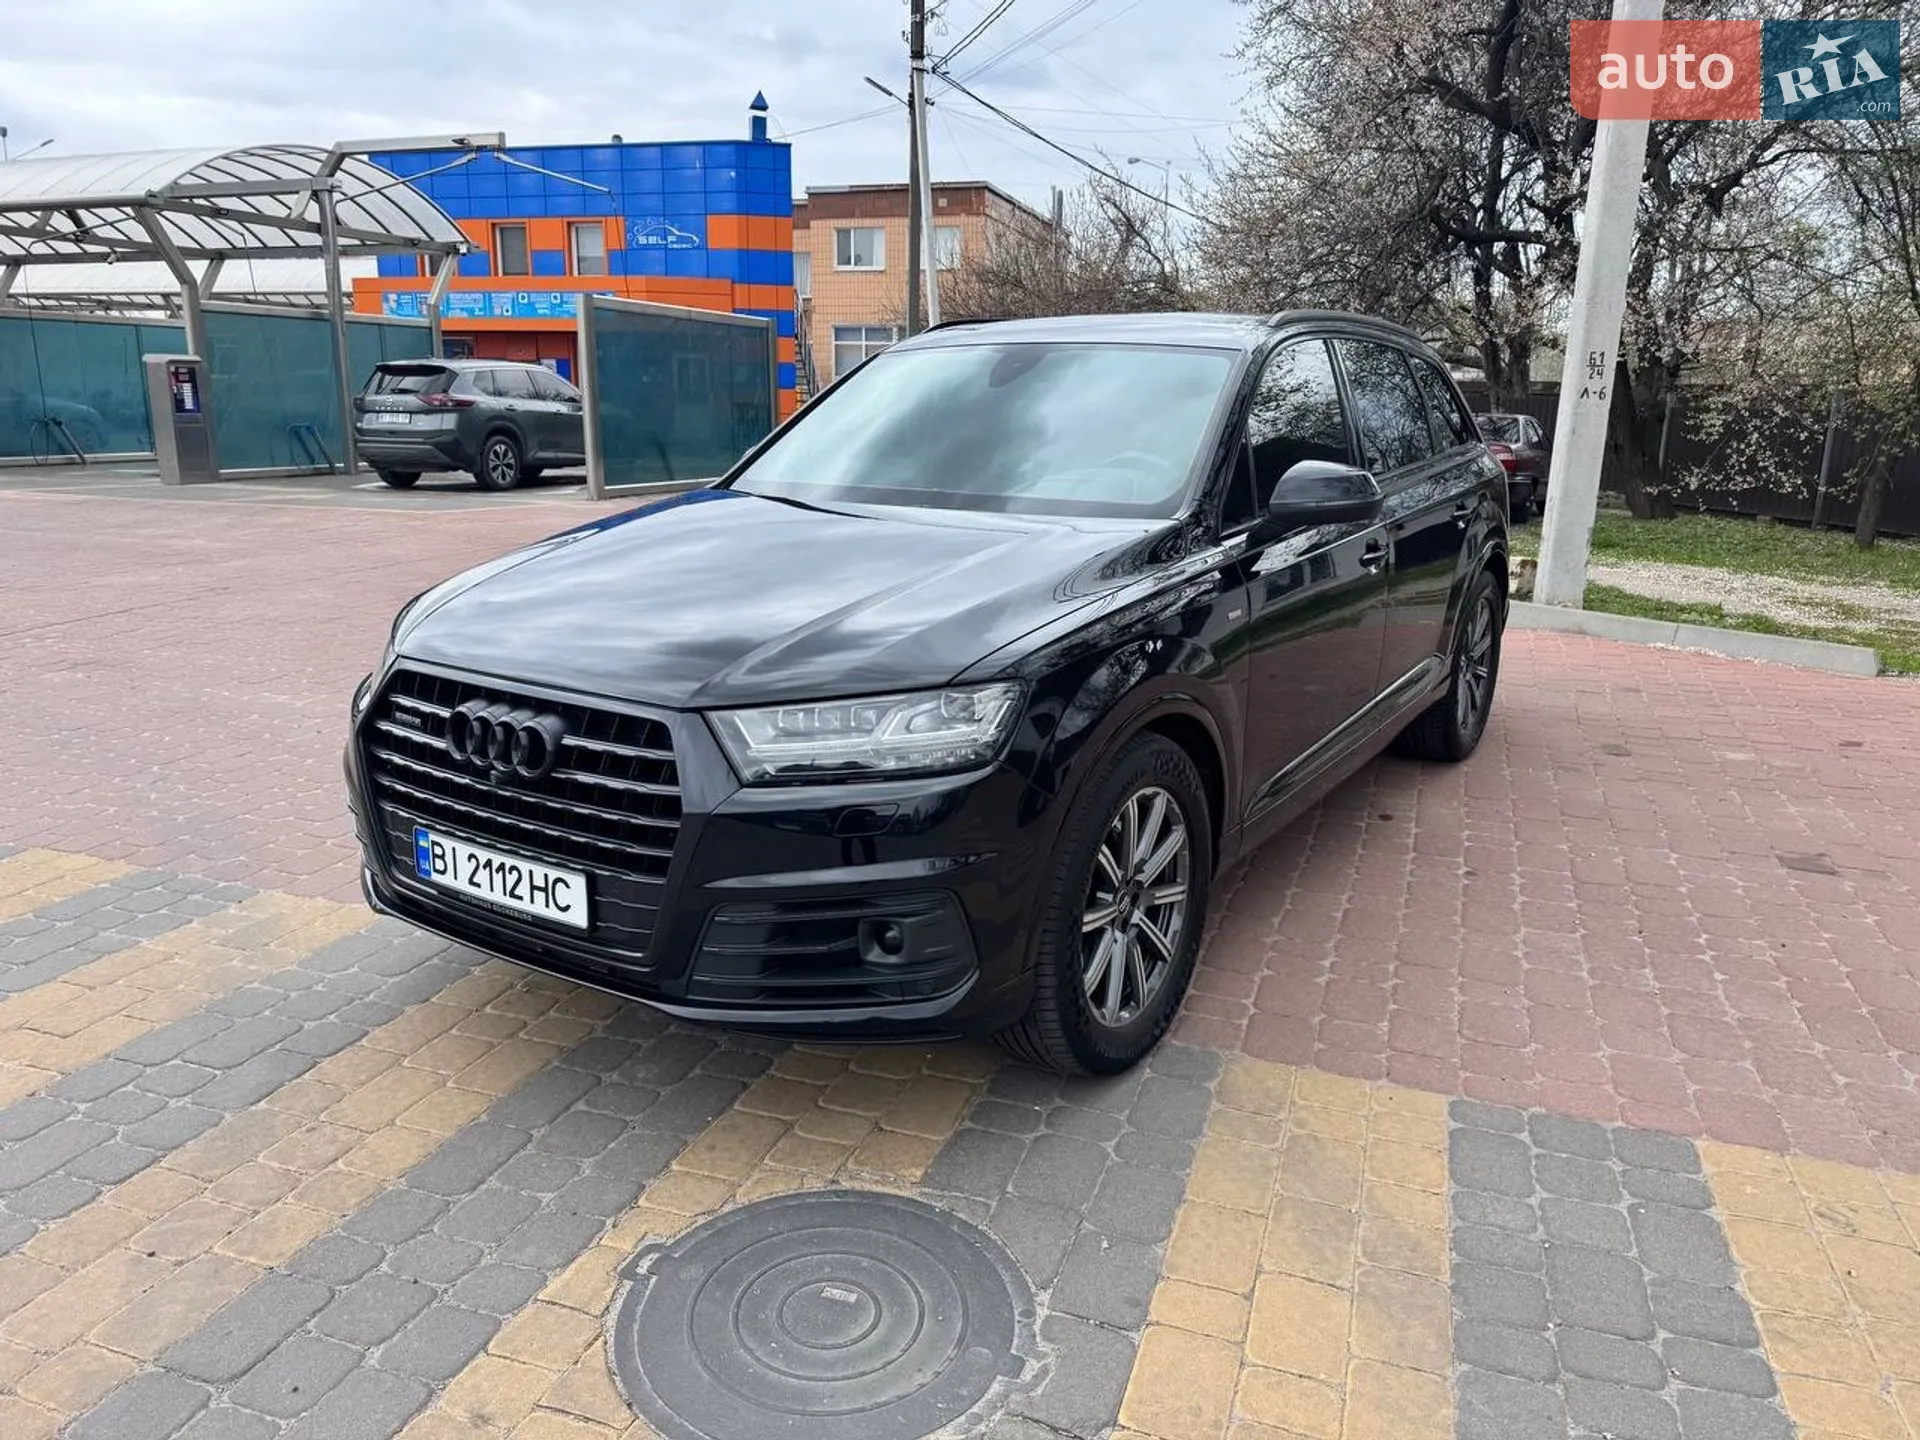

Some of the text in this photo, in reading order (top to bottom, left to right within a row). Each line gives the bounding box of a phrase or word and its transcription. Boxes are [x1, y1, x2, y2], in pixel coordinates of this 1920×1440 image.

[431, 840, 572, 913] BI 2112 HC
